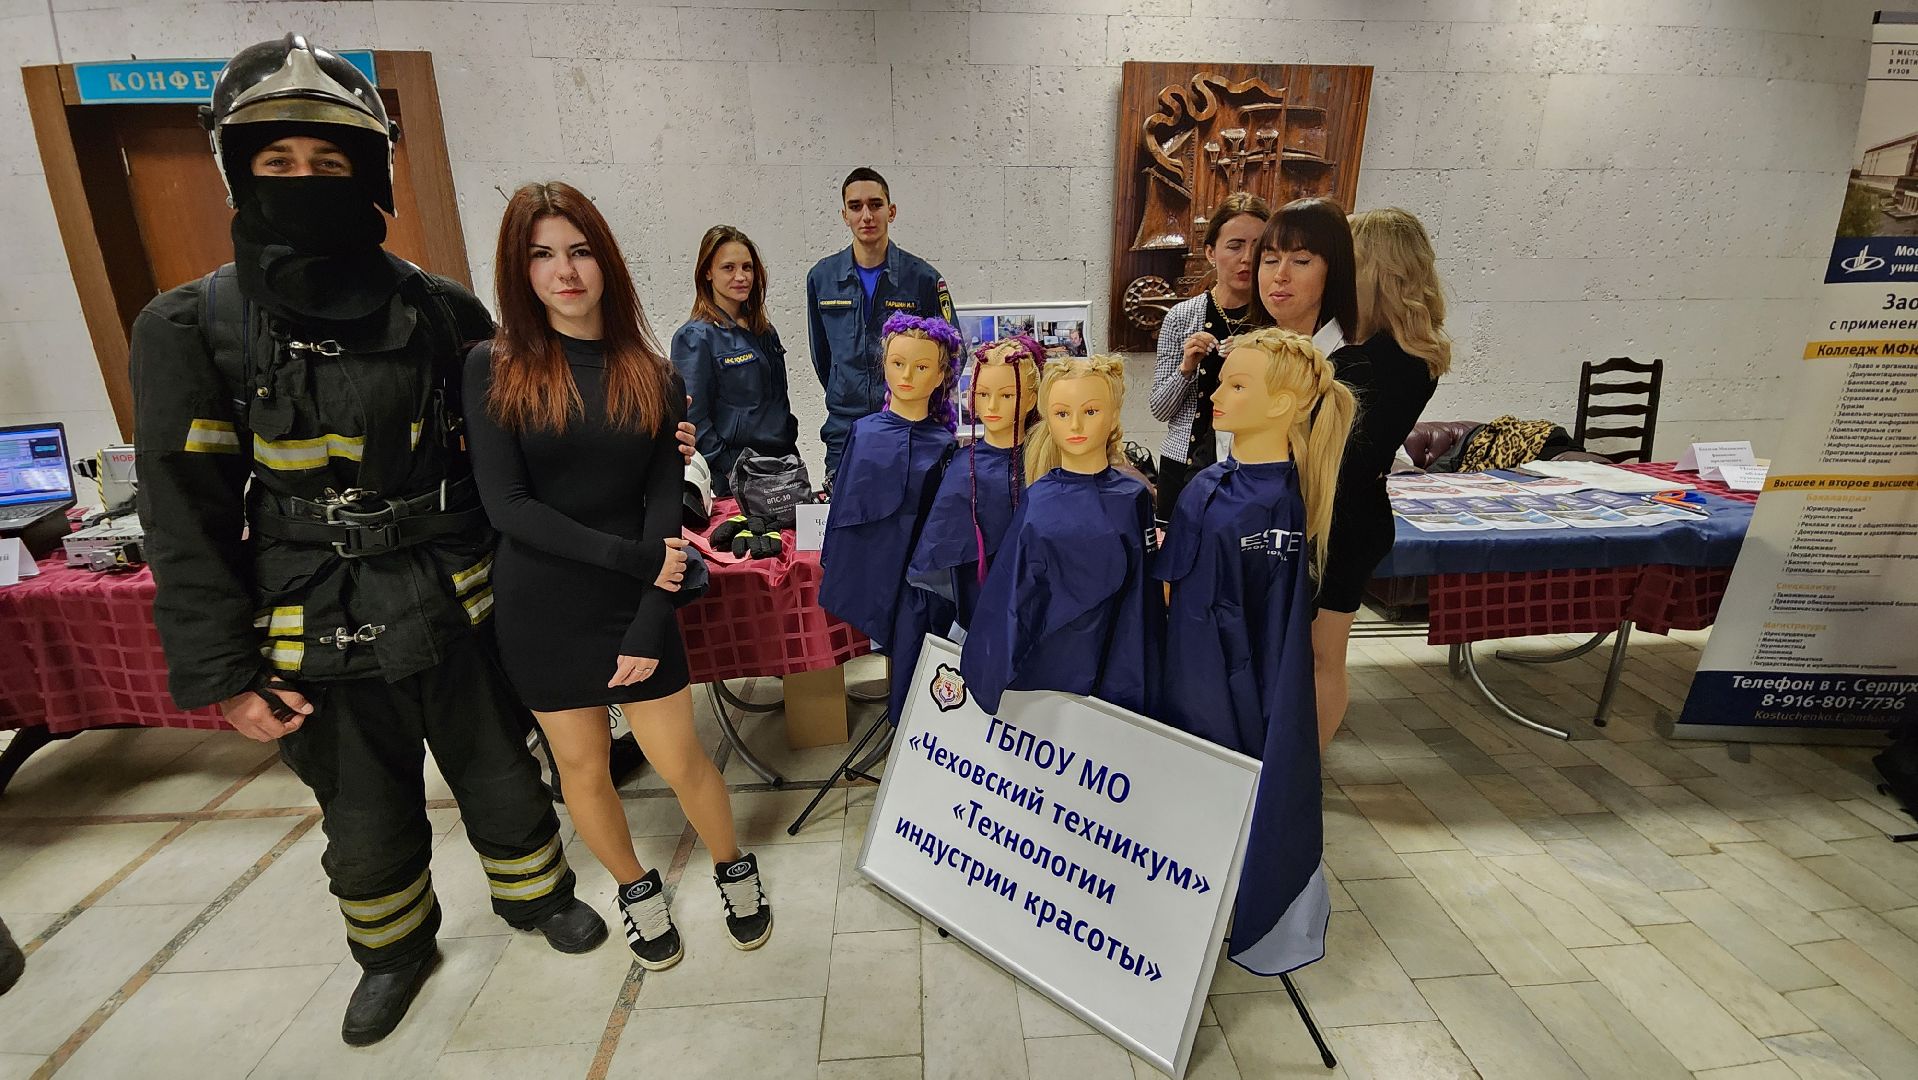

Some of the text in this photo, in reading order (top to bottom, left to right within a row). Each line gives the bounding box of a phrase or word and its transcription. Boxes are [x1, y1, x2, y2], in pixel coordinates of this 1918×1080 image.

[1882, 293, 1918, 311] Зао
[1829, 319, 1918, 333] с применен
[1817, 344, 1878, 357] Колледж
[1773, 479, 1815, 488] Высшее
[1828, 479, 1870, 489] второе
[1872, 480, 1914, 488] высшее
[1732, 675, 1815, 693] Телефон
[1819, 680, 1829, 691] в
[1834, 681, 1846, 691] г.
[1761, 694, 1906, 710] 8-916-801-7736
[985, 717, 1131, 804] ГБПОУ МО
[908, 732, 1211, 895] «Чеховский техникум»
[952, 800, 1117, 904] «Технологии
[894, 817, 1162, 982] индустрии красоты»
